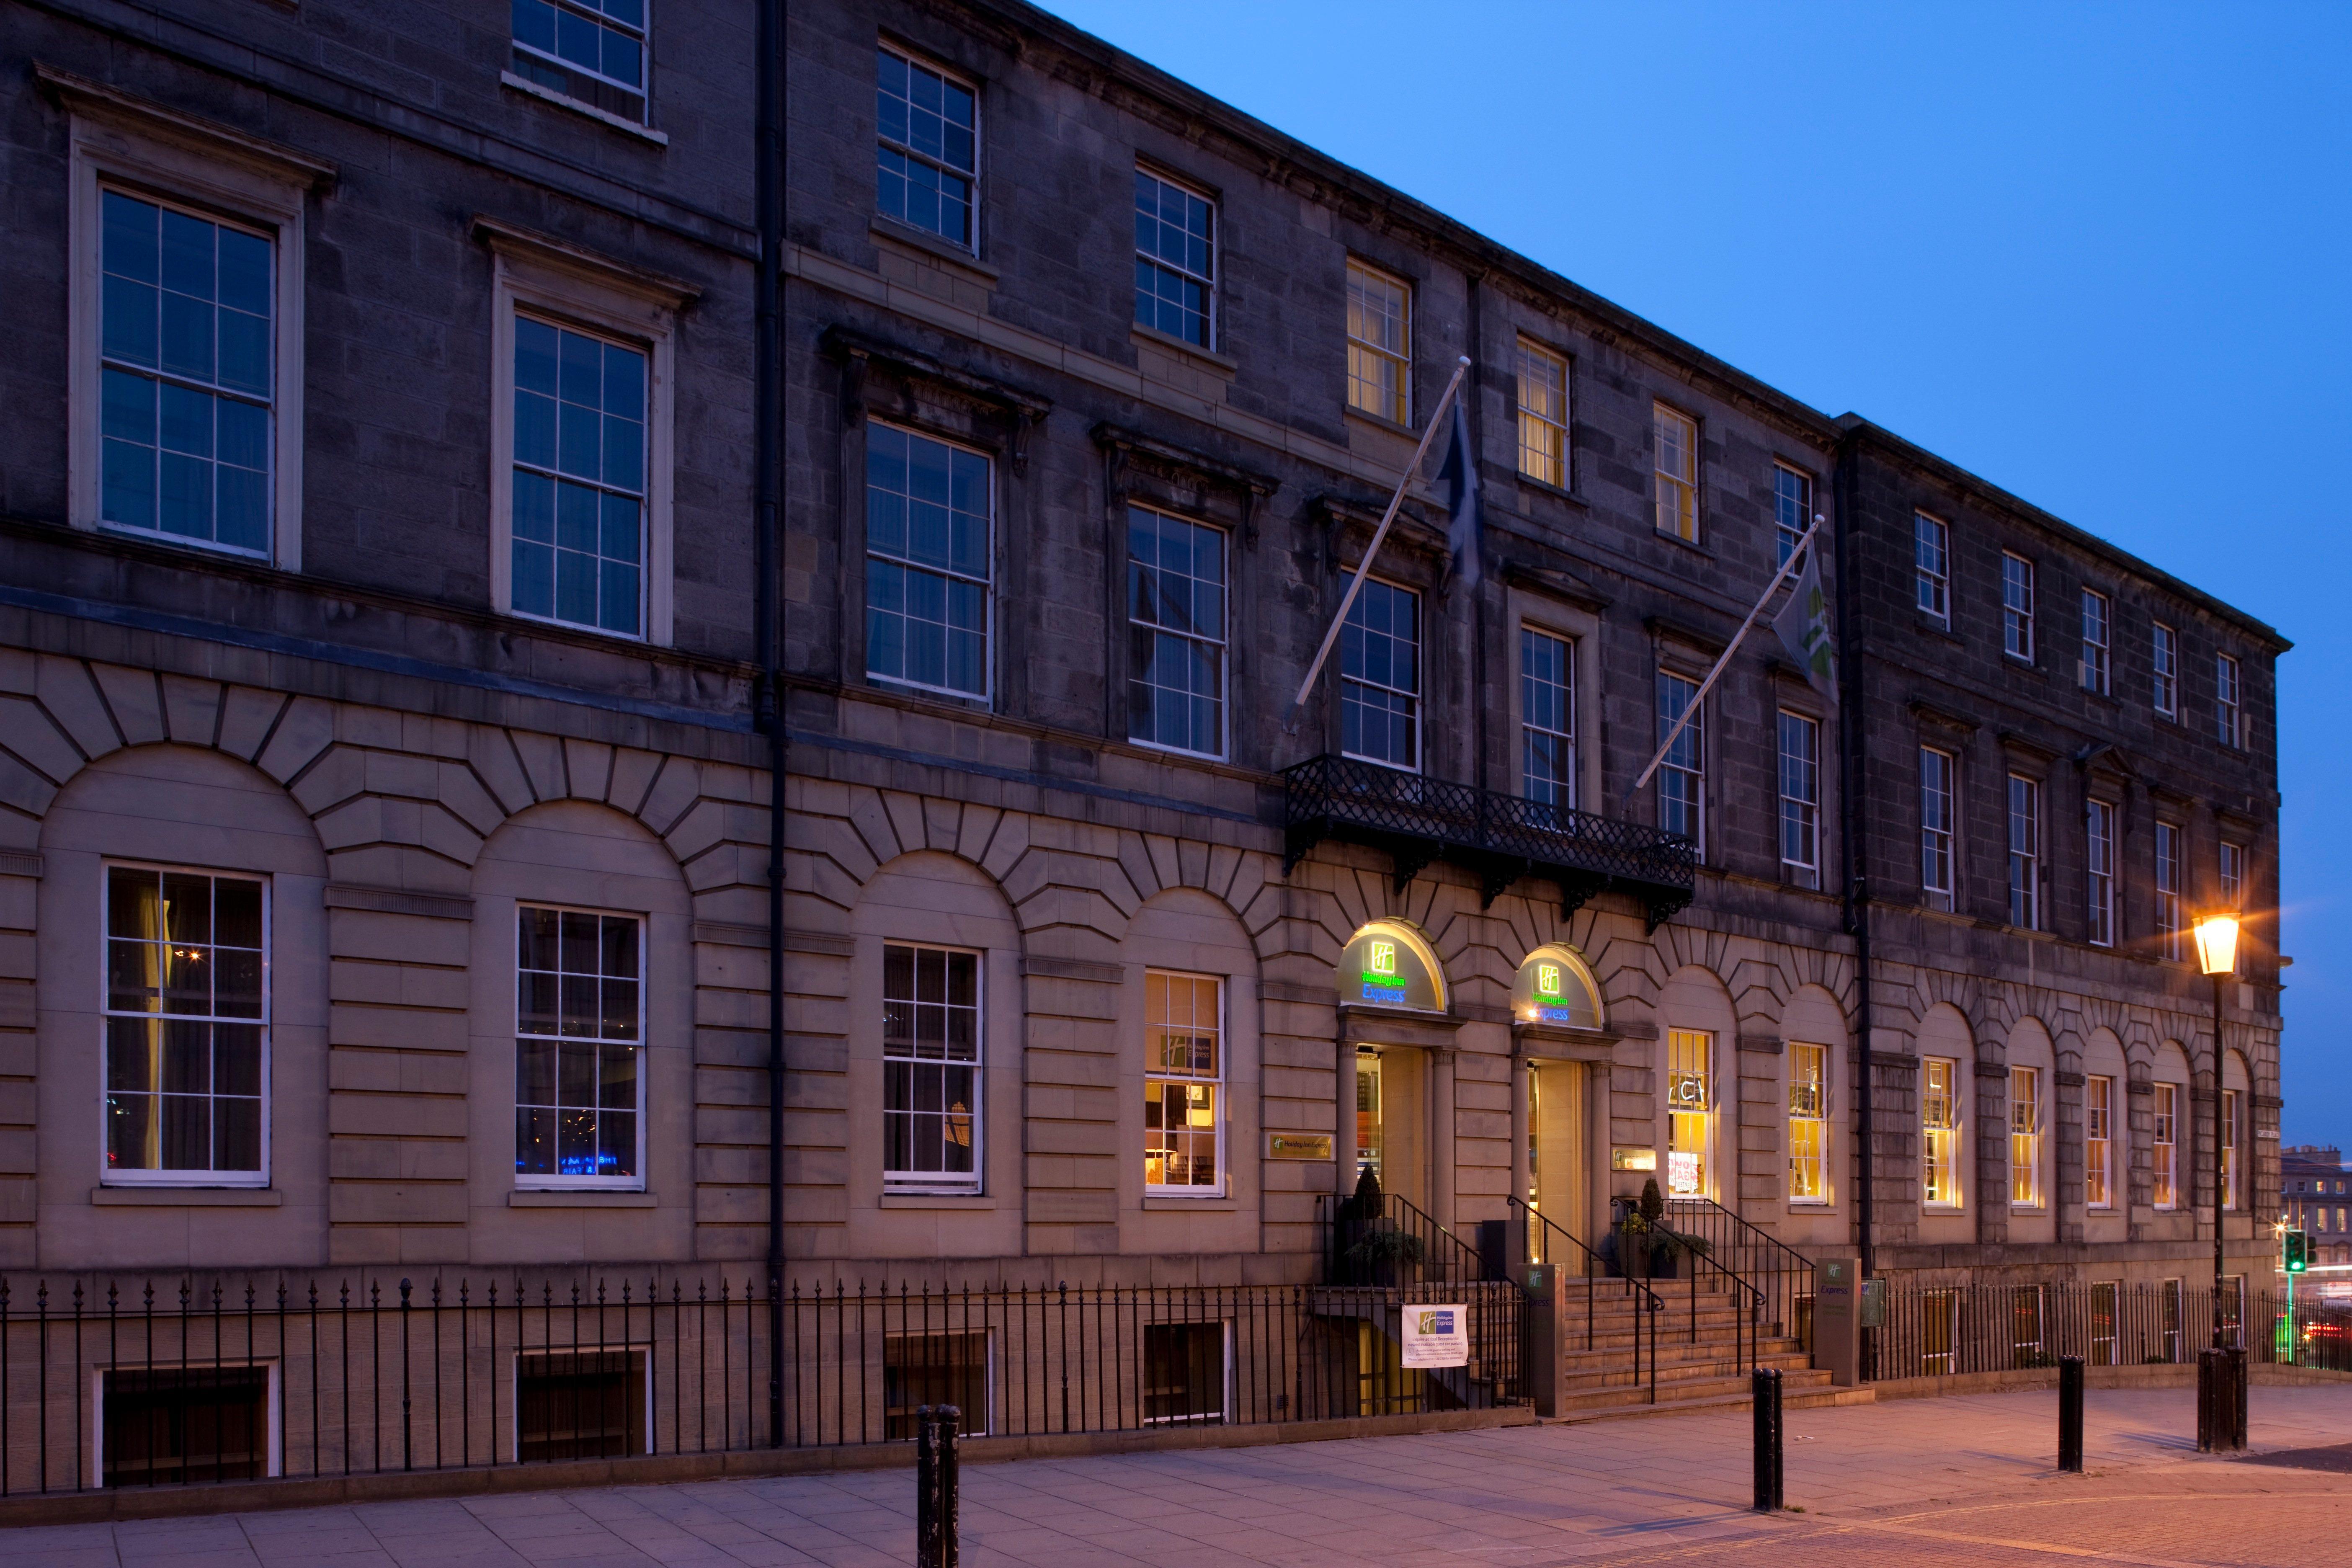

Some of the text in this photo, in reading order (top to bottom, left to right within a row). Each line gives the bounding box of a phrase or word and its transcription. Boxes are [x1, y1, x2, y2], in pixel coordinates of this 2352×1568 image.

[1362, 971, 1405, 987] Holiday Inn
[1363, 983, 1405, 1003] Express
[1532, 992, 1568, 1006] Holiday Inn
[1188, 1050, 1209, 1058] Epress
[1821, 1285, 1848, 1295] Express
